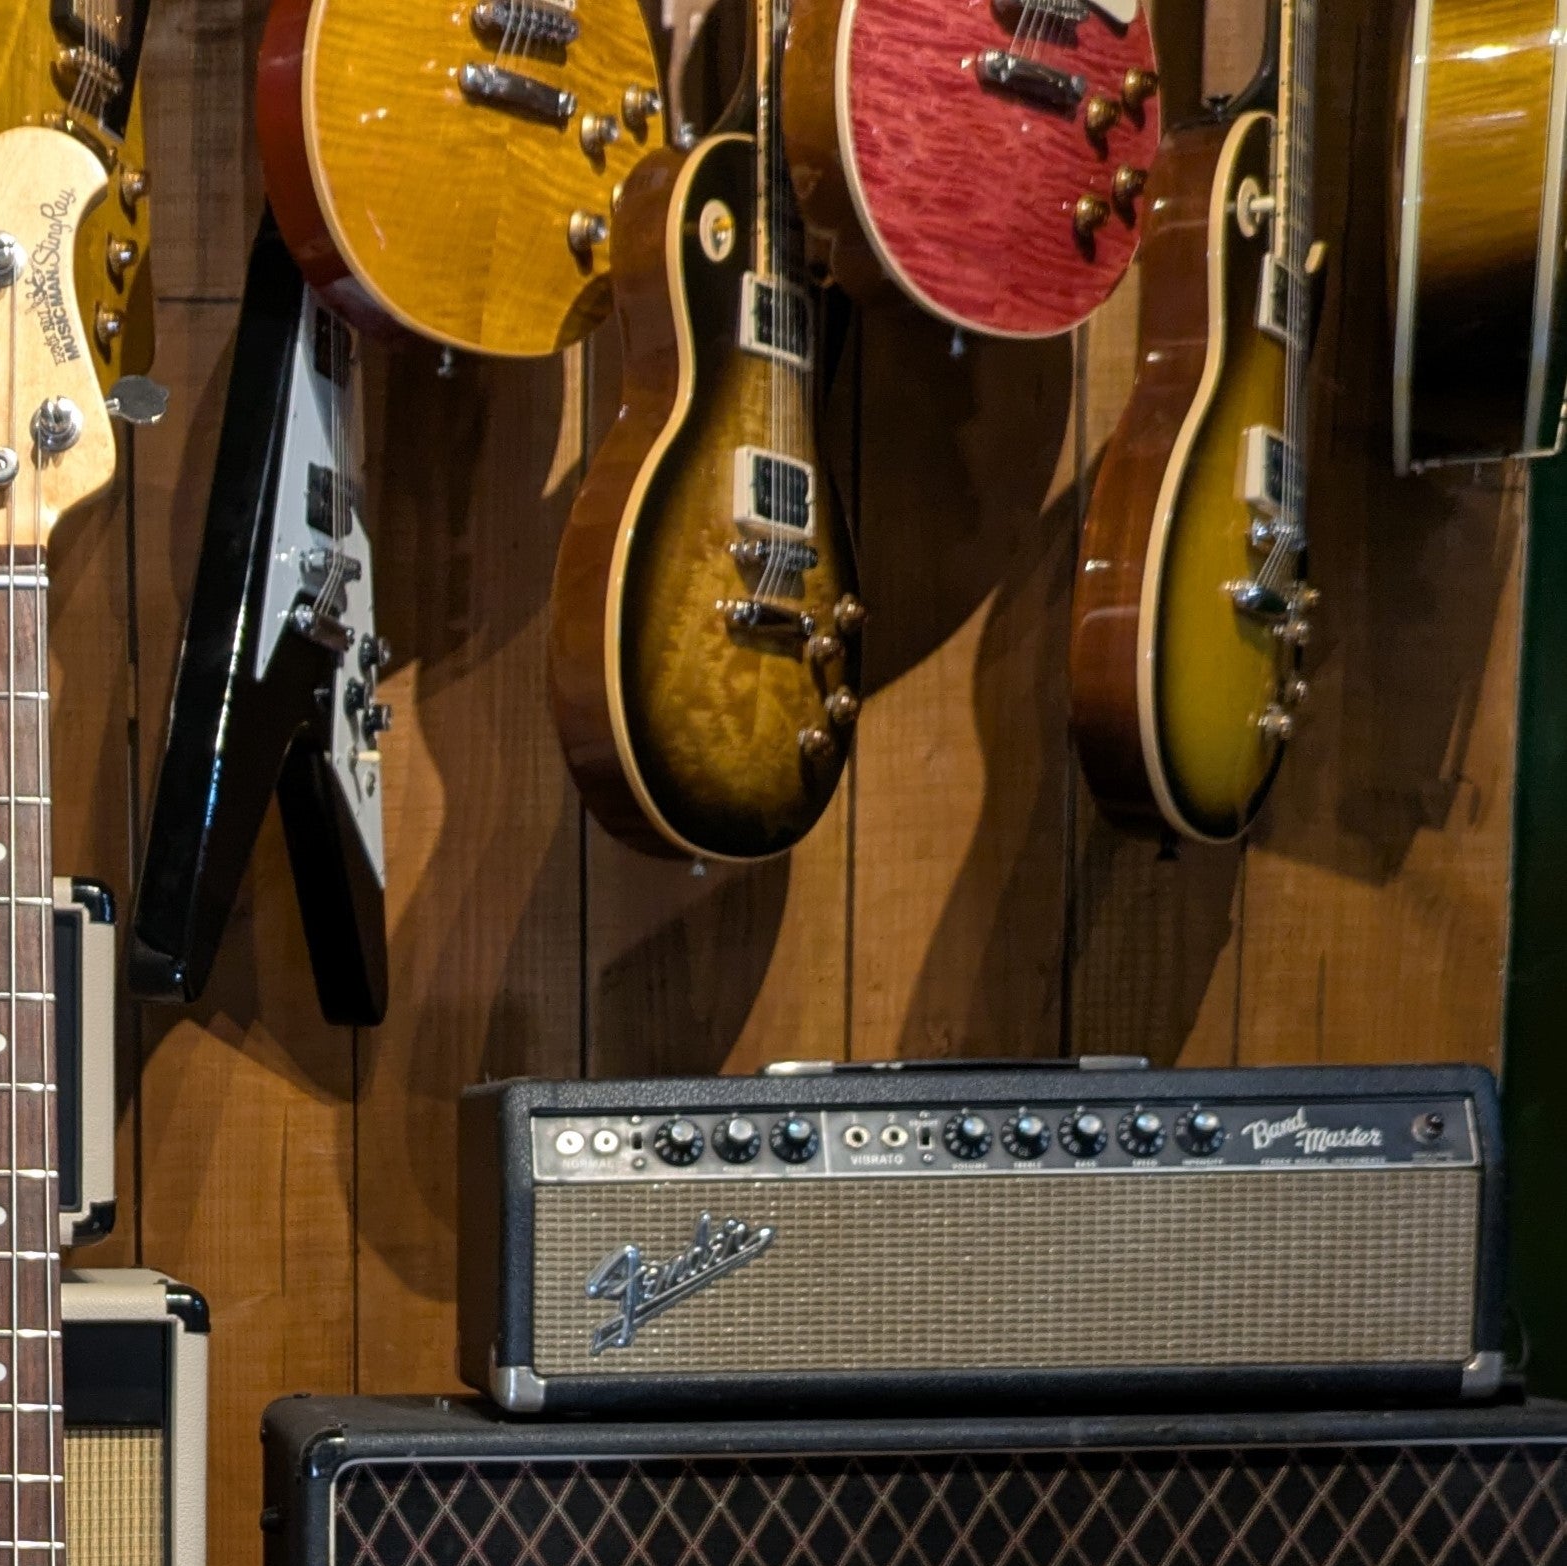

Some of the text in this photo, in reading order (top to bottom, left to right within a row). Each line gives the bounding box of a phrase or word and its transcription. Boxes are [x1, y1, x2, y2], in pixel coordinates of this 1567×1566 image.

[46, 266, 81, 362] MUSIC MAN
[1241, 1106, 1308, 1150] Band
[562, 1159, 612, 1169] NORMAL
[850, 1154, 904, 1165] VIBRATO
[584, 1209, 777, 1357] Fender
